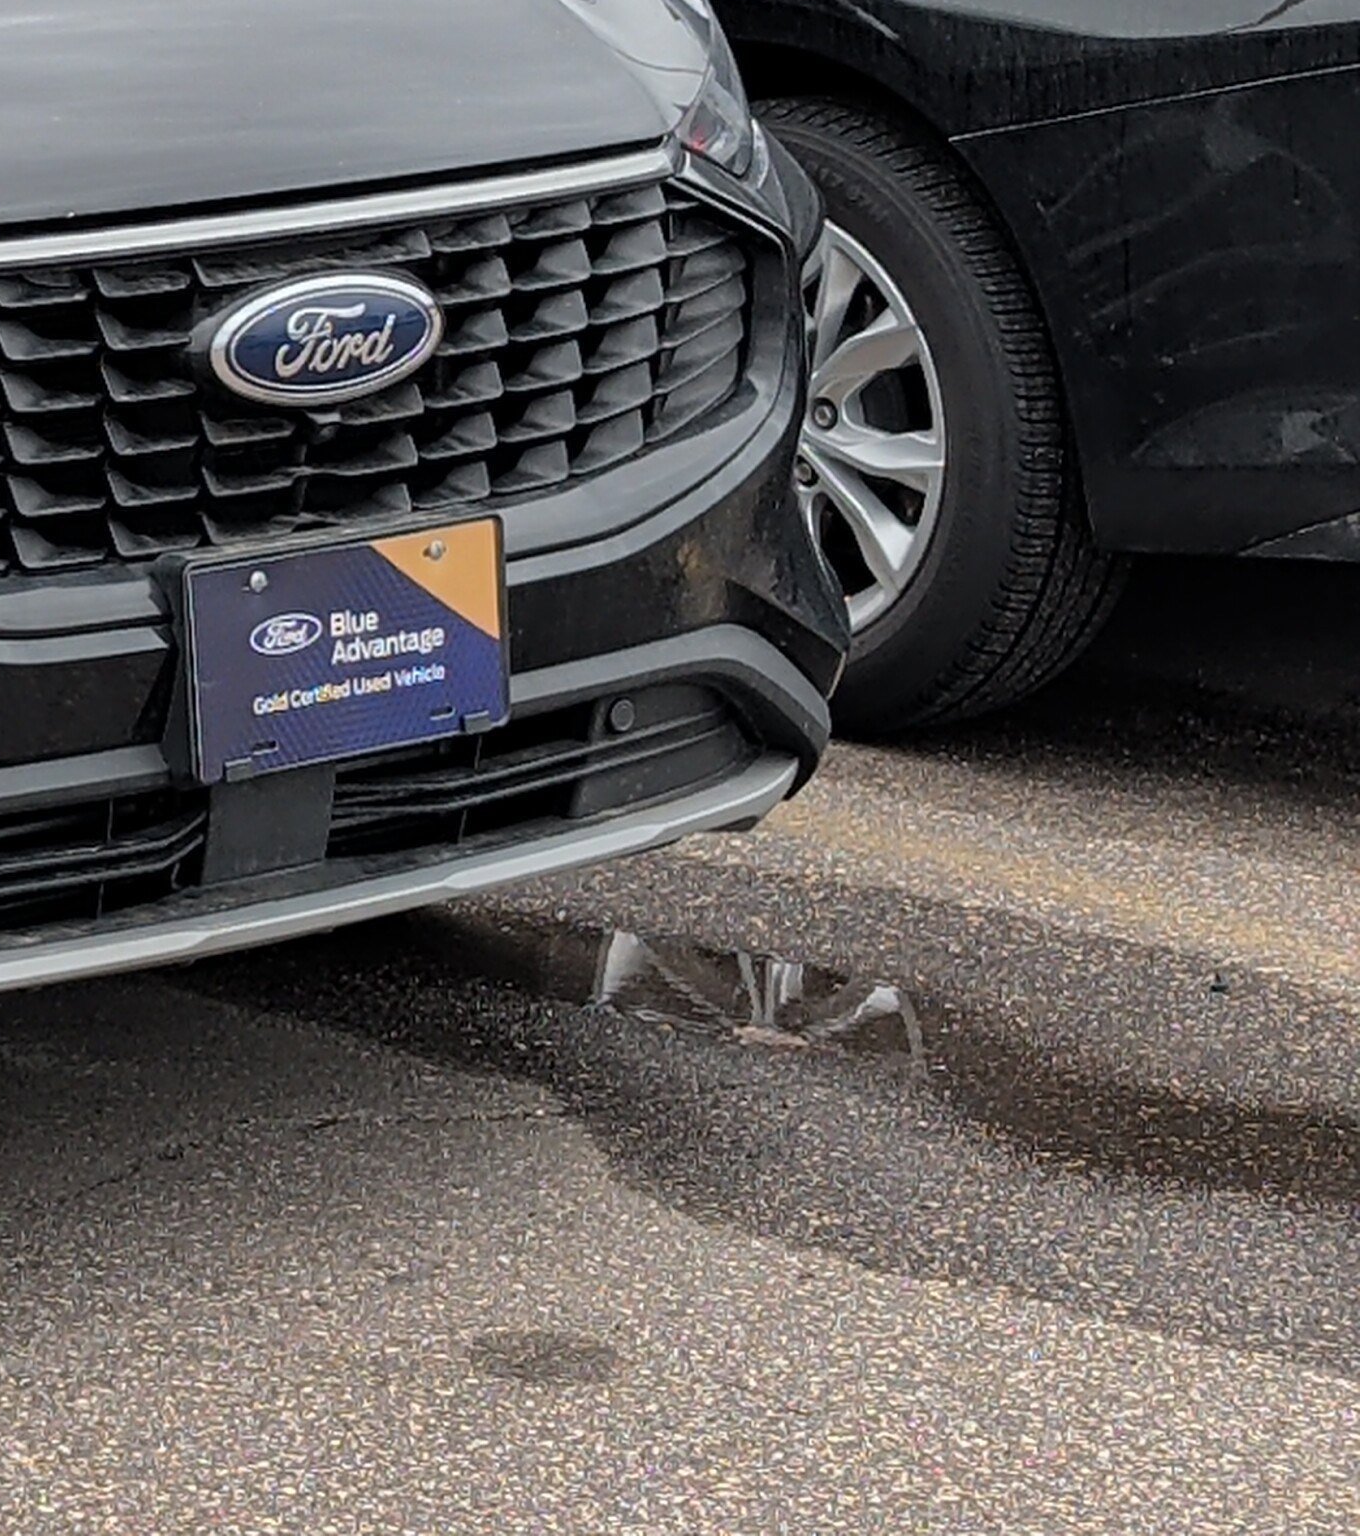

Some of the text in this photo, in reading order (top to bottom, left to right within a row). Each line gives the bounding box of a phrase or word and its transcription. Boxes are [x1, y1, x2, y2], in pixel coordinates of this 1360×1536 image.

[274, 302, 396, 378] Ford
[263, 620, 308, 649] Ford
[330, 610, 379, 637] Blue
[332, 627, 445, 665] Advantage
[253, 664, 445, 715] Gold Certified Used Vehicle
